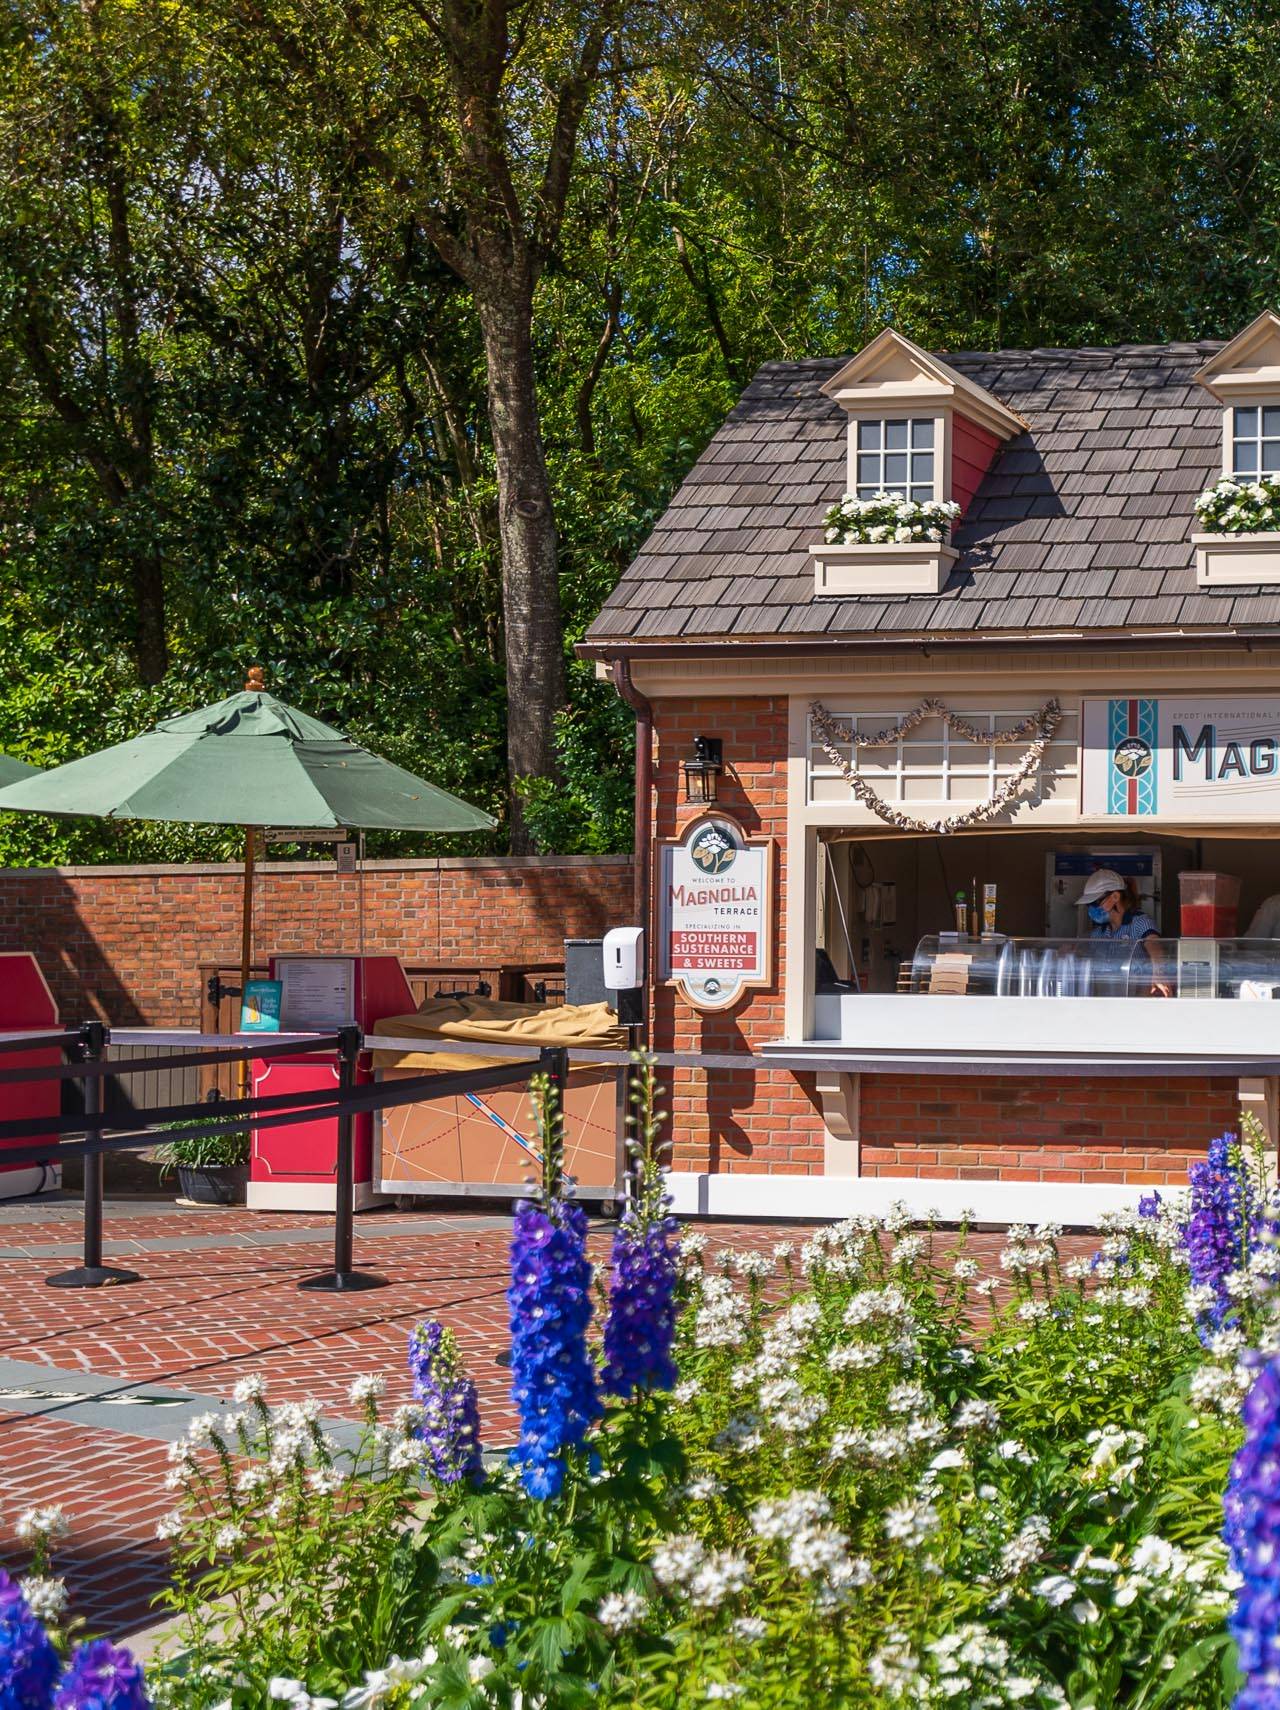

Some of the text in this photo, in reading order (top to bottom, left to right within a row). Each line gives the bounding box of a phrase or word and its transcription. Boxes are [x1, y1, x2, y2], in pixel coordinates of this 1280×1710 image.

[1172, 712, 1200, 720] EPCOT
[1203, 711, 1273, 720] INTERNATIONAL
[714, 907, 758, 915] TERRACE
[680, 933, 747, 944] SOUTHERN
[674, 943, 754, 954] SUSTENANCE
[683, 958, 744, 968] & SWEETS
